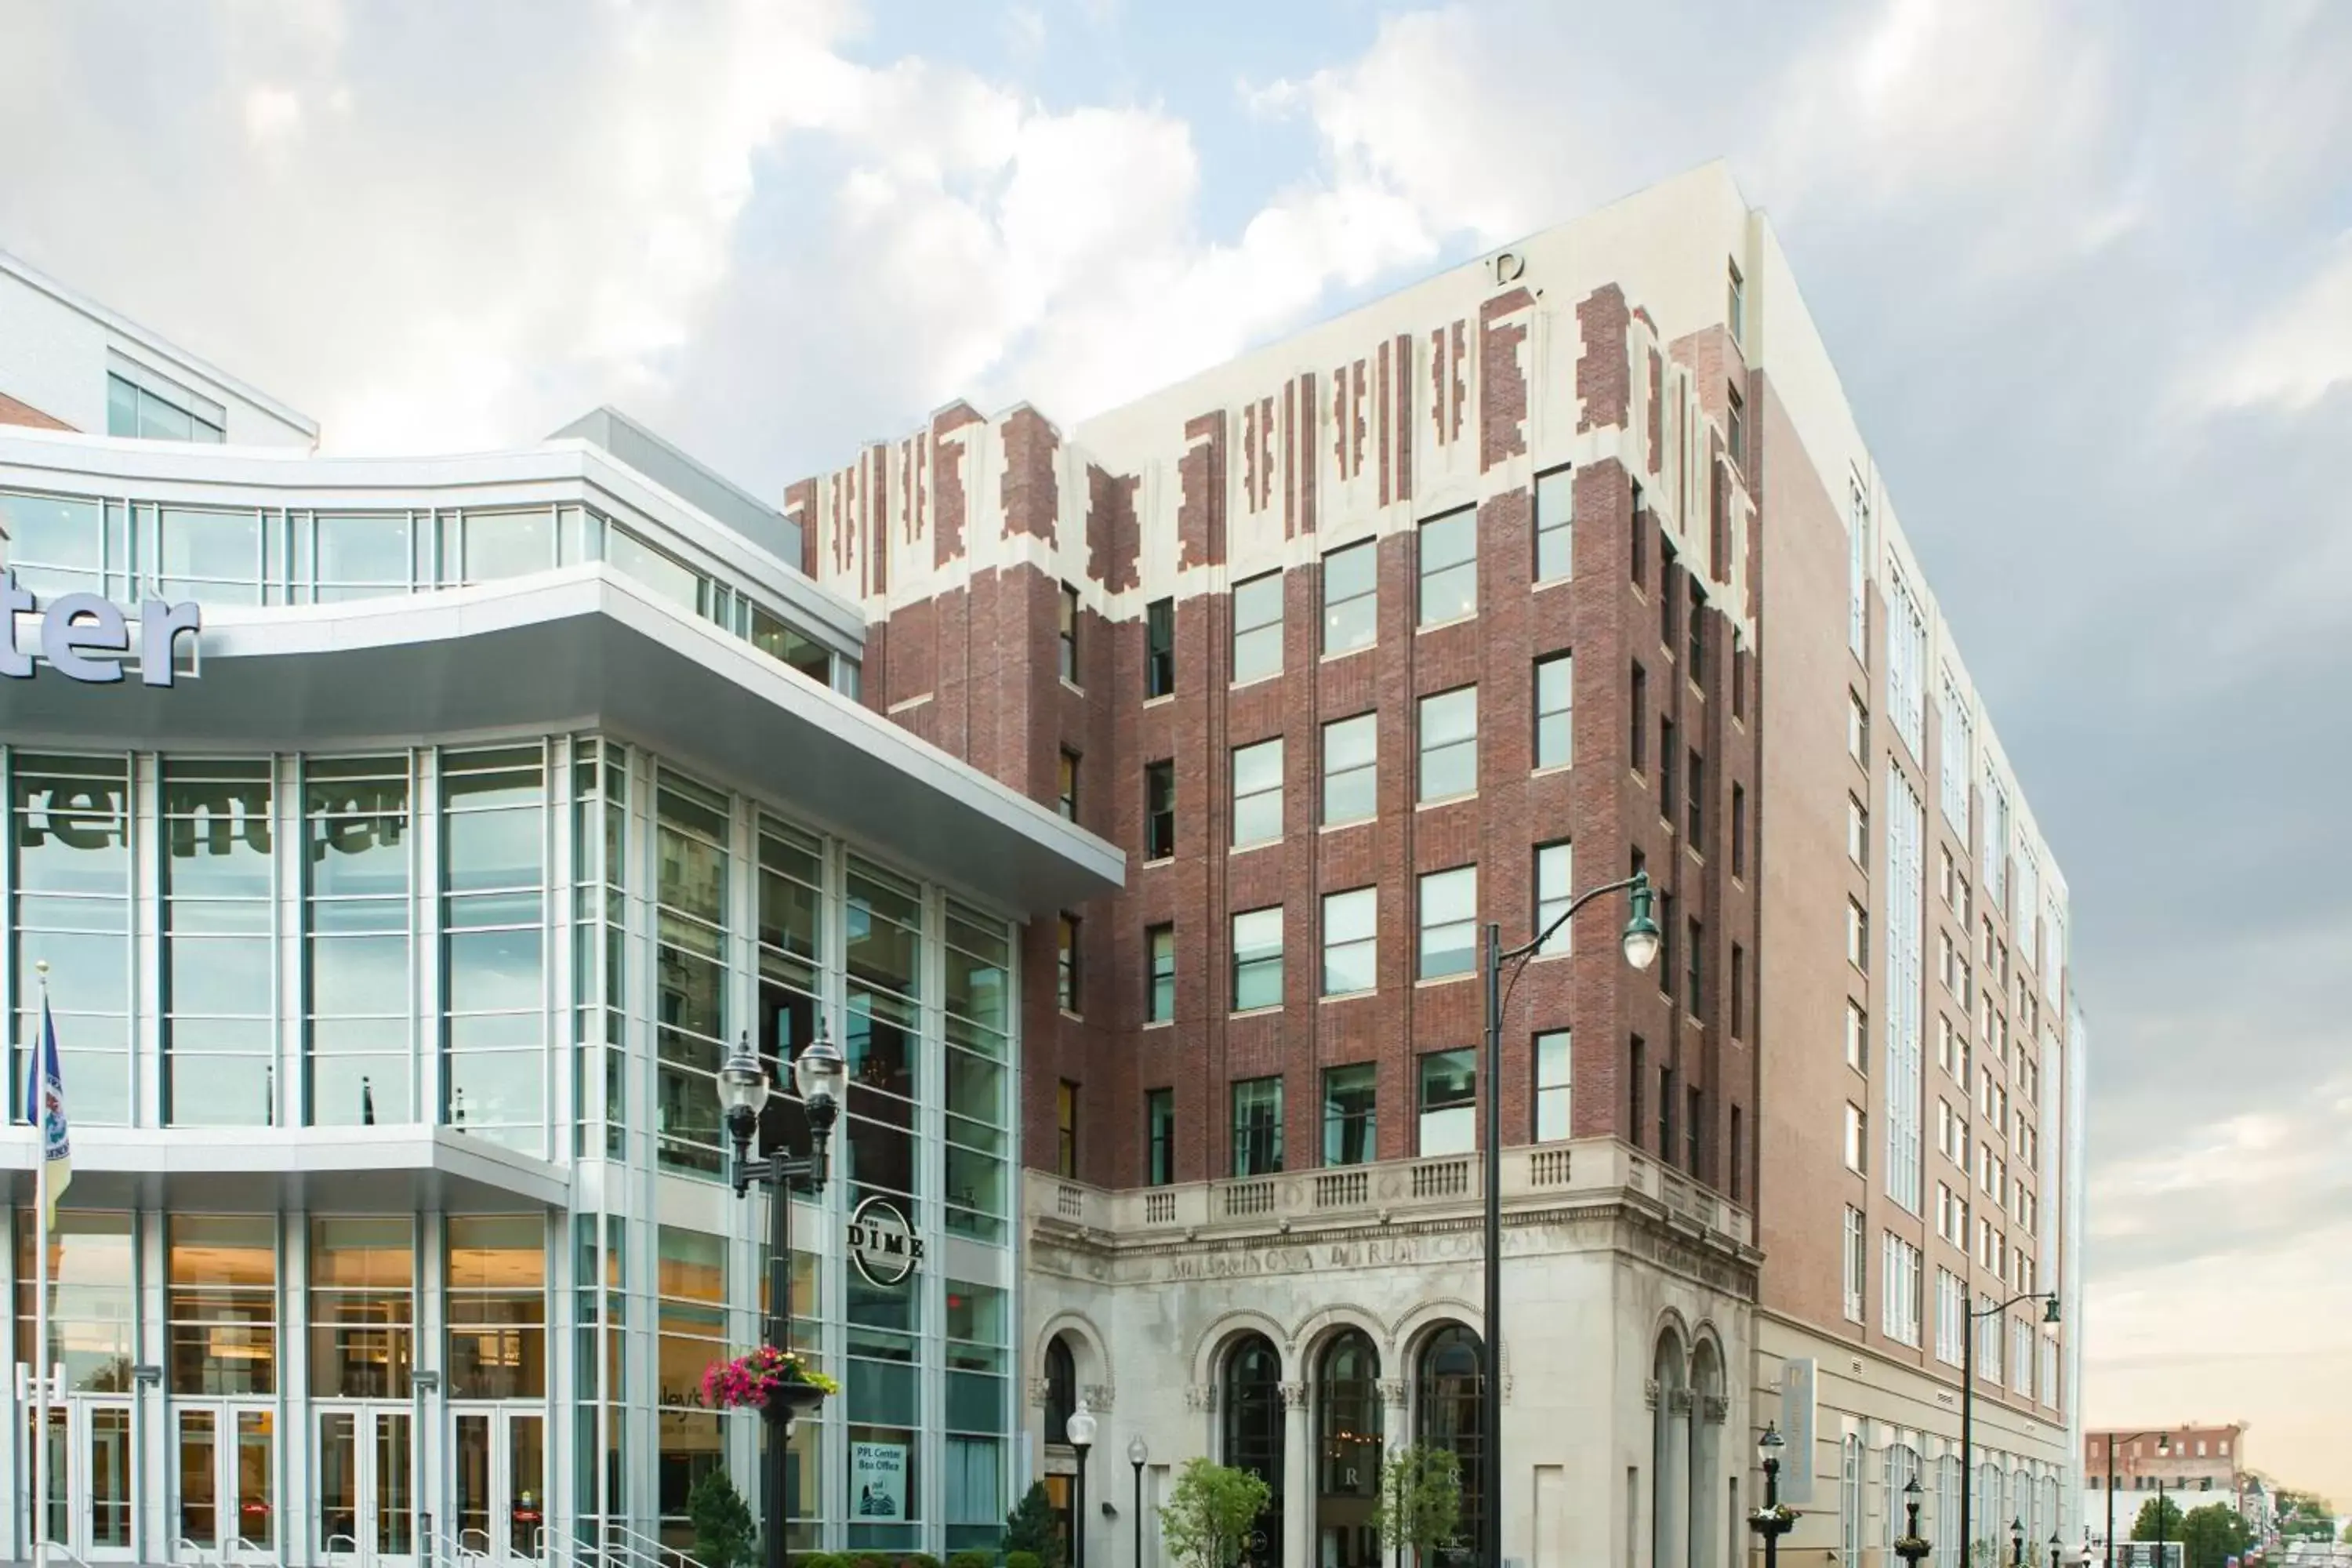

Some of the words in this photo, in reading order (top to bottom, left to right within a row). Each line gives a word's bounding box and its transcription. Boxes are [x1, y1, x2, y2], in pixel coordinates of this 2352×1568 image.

[848, 1225, 924, 1258] DIME
[857, 1447, 873, 1457] PPL
[874, 1449, 901, 1459] Center
[858, 1459, 874, 1470] Box
[876, 1460, 900, 1471] Office
[1345, 1468, 1361, 1485] R
[1448, 1467, 1462, 1485] R
